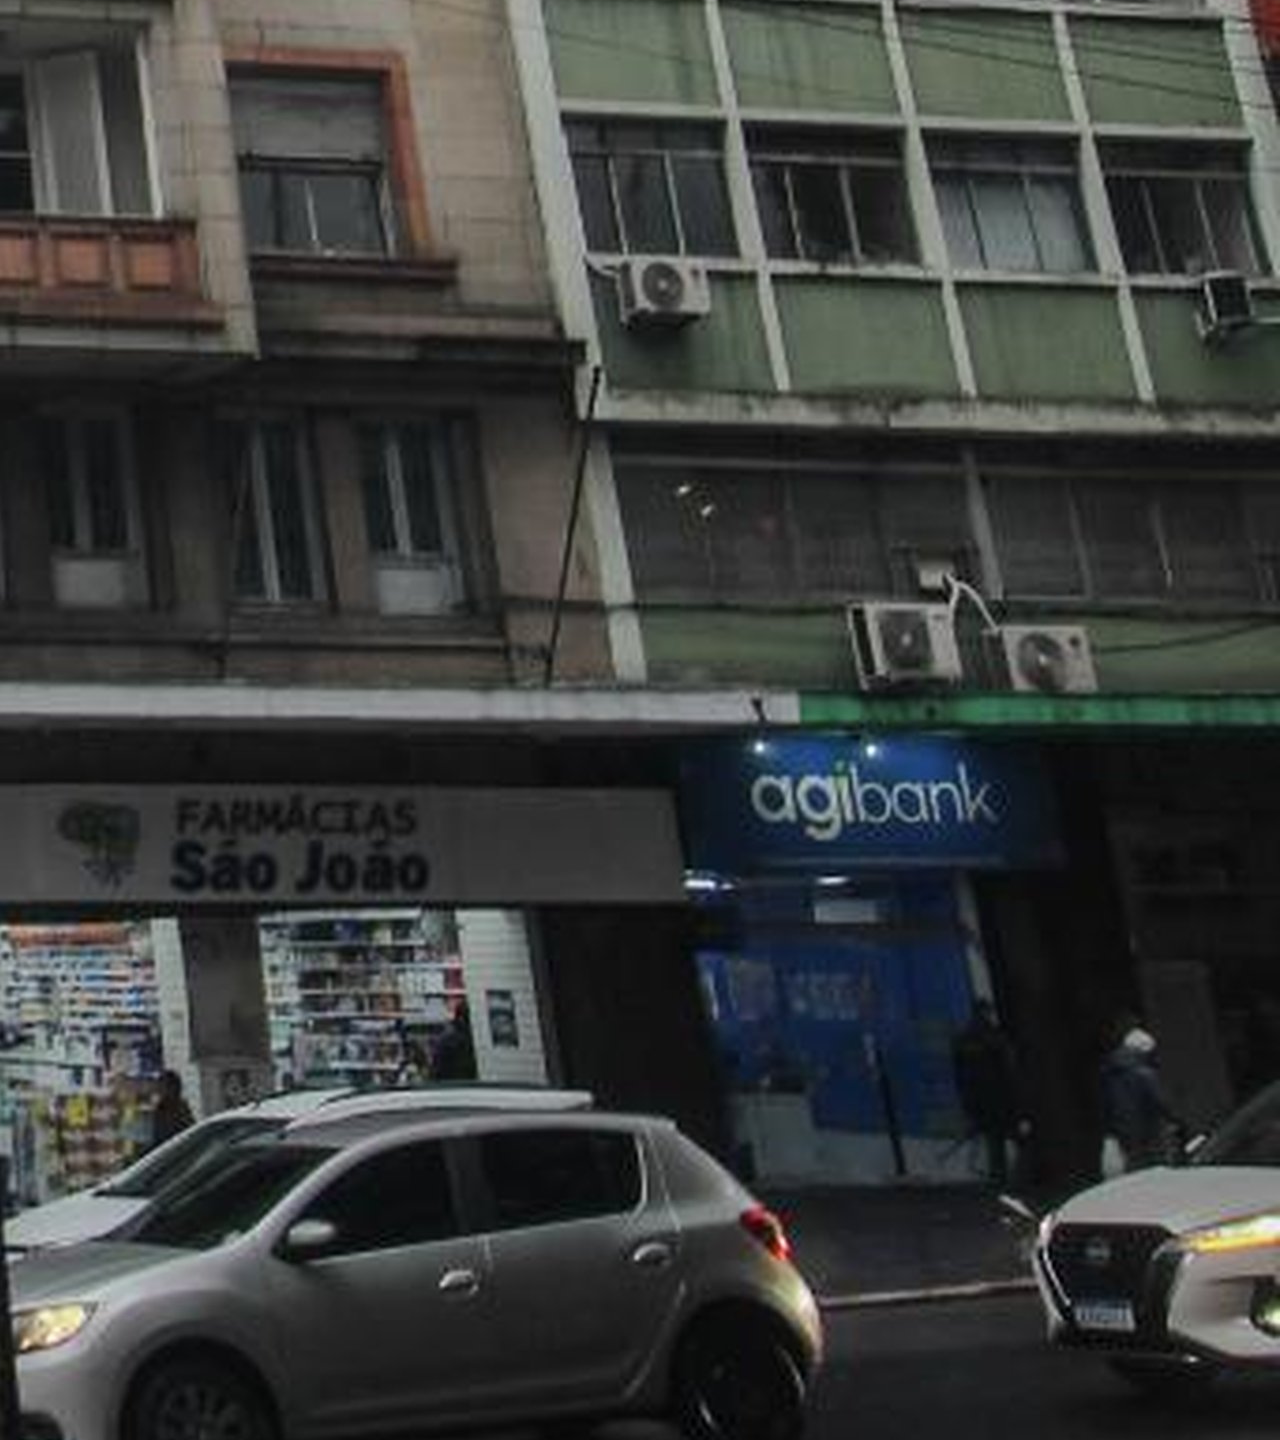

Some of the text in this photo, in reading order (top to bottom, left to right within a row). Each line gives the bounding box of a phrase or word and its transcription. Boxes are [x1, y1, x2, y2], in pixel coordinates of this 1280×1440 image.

[175, 794, 418, 836] FARMÁCIAS
[751, 760, 1001, 841] agibank
[170, 838, 430, 893] São João
